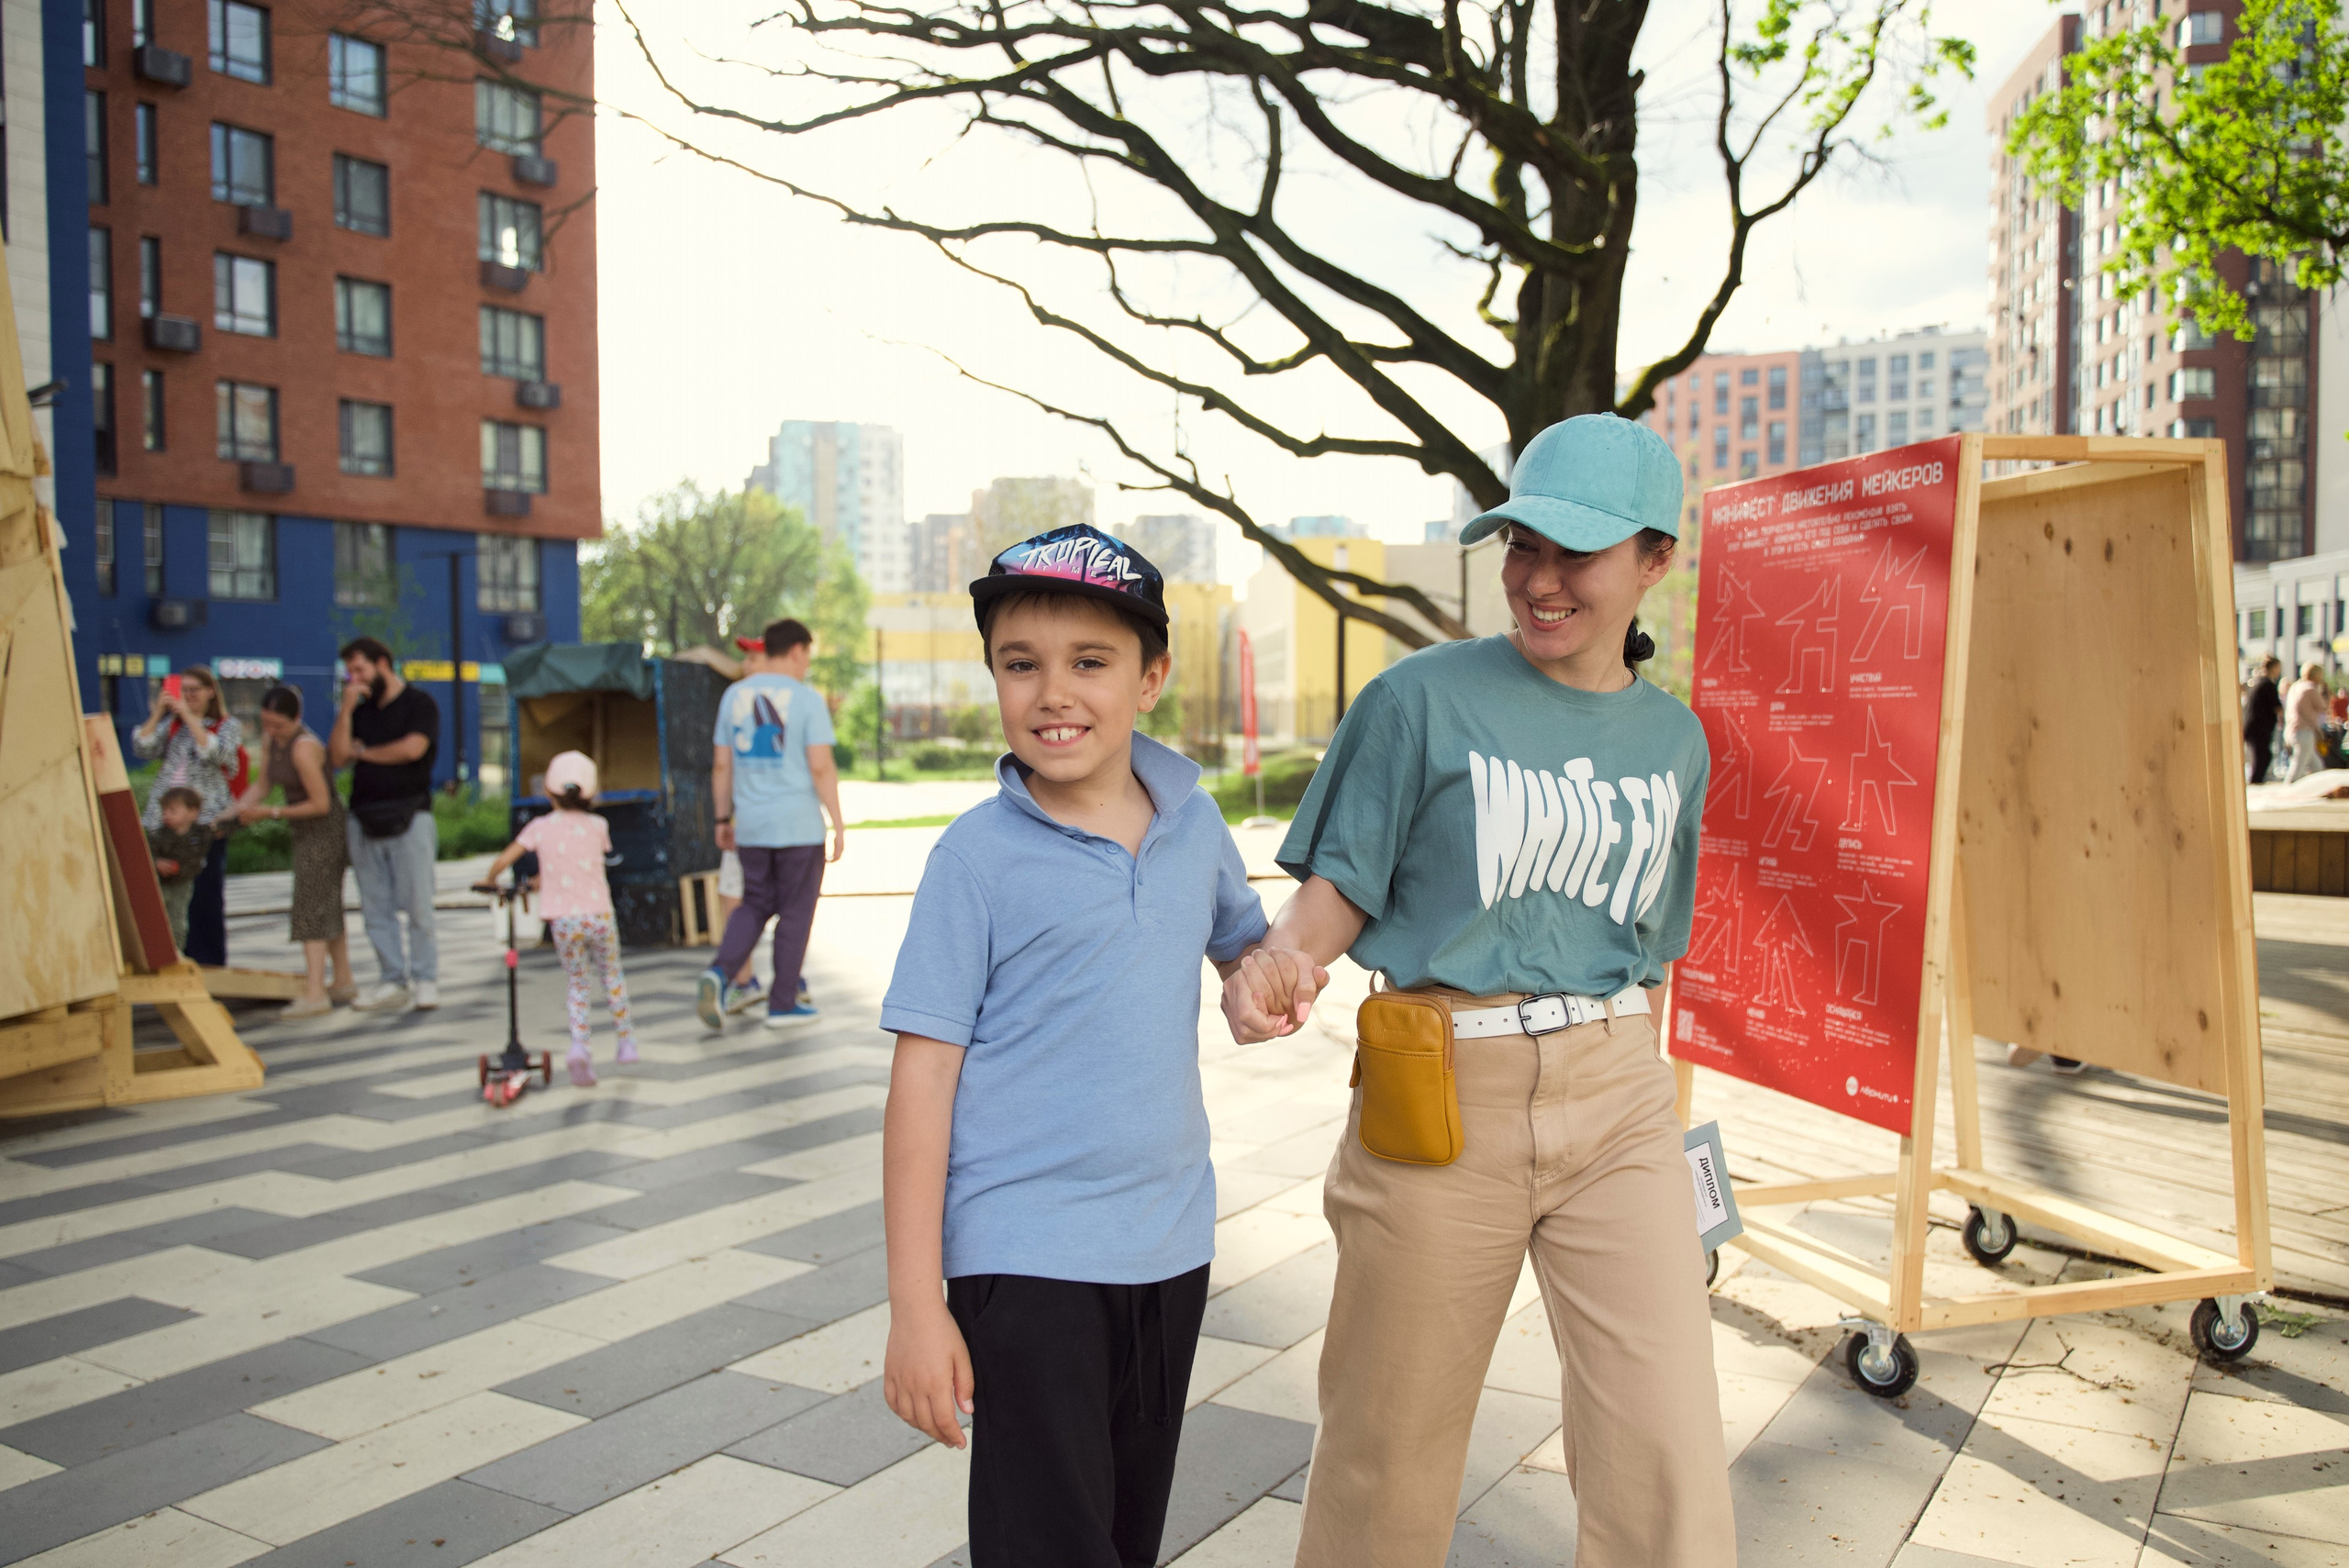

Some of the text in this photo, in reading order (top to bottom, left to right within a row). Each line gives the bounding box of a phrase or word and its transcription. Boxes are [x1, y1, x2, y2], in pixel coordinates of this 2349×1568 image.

[1711, 462, 1943, 526] МАНИФЕСТ ДВИЖЕНИЯ МЕЙКЕРОВ
[1019, 537, 1142, 581] TROPICAL
[1041, 565, 1114, 582] TIMES
[1469, 751, 1622, 911] WHITE
[1698, 1157, 1720, 1209] ДИПЛОМ
